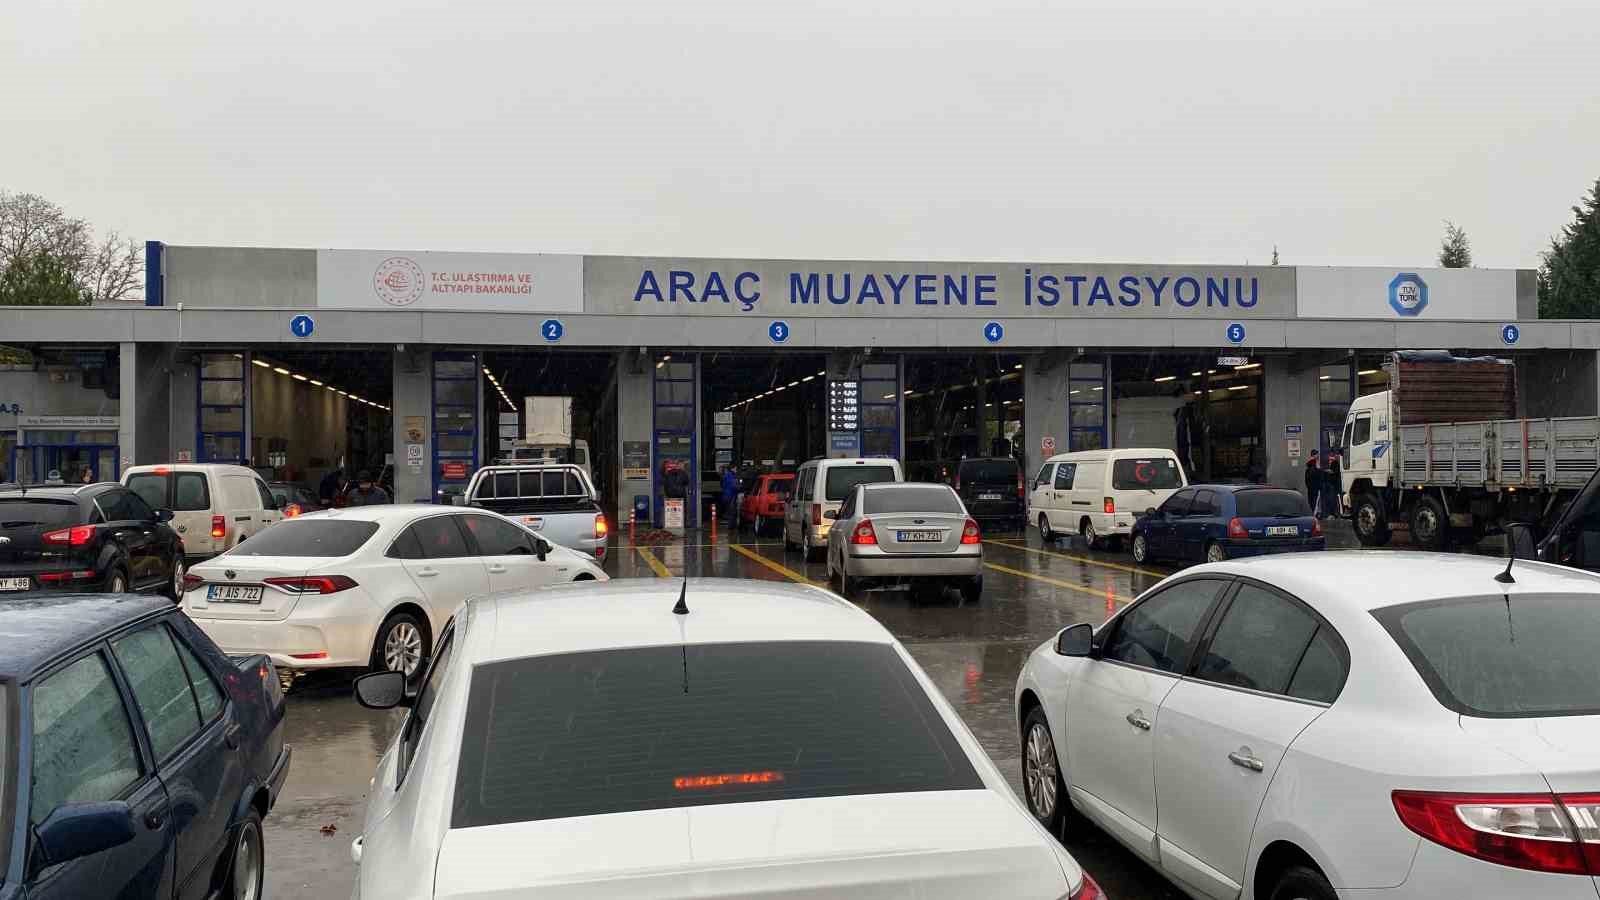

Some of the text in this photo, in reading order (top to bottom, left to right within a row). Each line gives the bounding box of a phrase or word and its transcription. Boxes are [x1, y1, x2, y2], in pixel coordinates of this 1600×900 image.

[431, 272, 449, 281] T.C.
[518, 273, 532, 283] VE
[431, 284, 532, 294] ALTYAPI BAKANLIĞI
[633, 268, 1258, 312] ARAÇ MUAYENE İSTASYONU
[299, 320, 306, 333] 1
[548, 324, 557, 337] 2
[775, 326, 783, 338] 3
[990, 327, 997, 338] 4
[1233, 327, 1240, 338] 5
[1507, 329, 1514, 340] 6
[242, 587, 258, 599] 722
